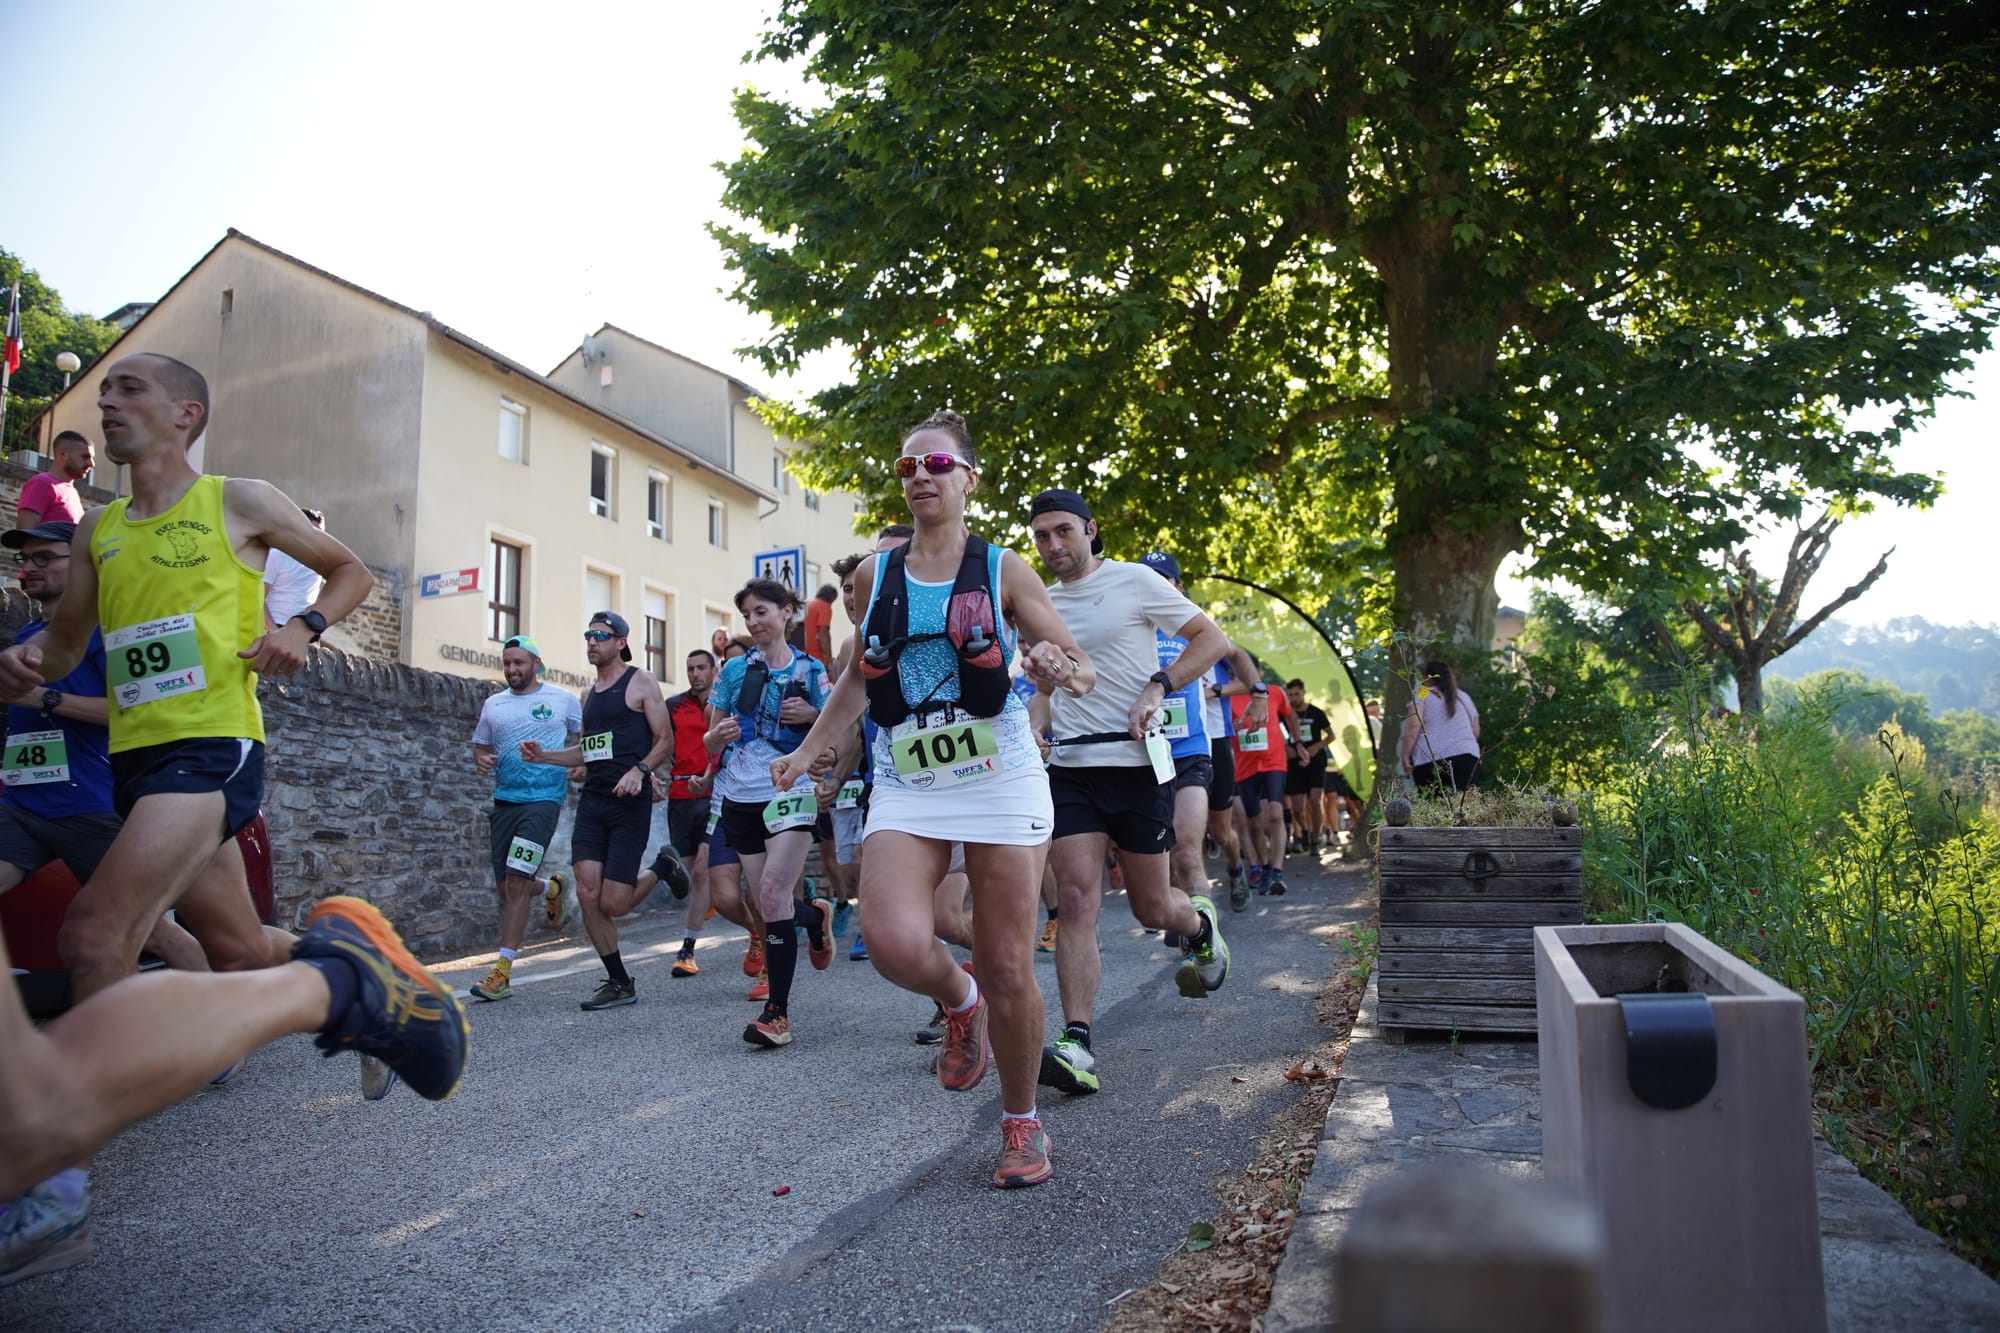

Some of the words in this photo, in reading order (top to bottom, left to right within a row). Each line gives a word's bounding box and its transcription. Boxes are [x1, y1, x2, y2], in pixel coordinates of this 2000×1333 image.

[155, 522, 177, 536] EVEIL
[150, 554, 210, 568] ATHLETISME
[428, 575, 471, 589] GENDARMERIE
[126, 641, 171, 679] 89
[440, 643, 503, 671] GENDARM
[581, 735, 606, 752] 105
[908, 727, 979, 769] 101
[16, 745, 47, 767] 48
[952, 764, 984, 776] TUFF'S
[842, 787, 859, 799] 78
[777, 797, 803, 816] 57
[514, 846, 534, 862] 83
